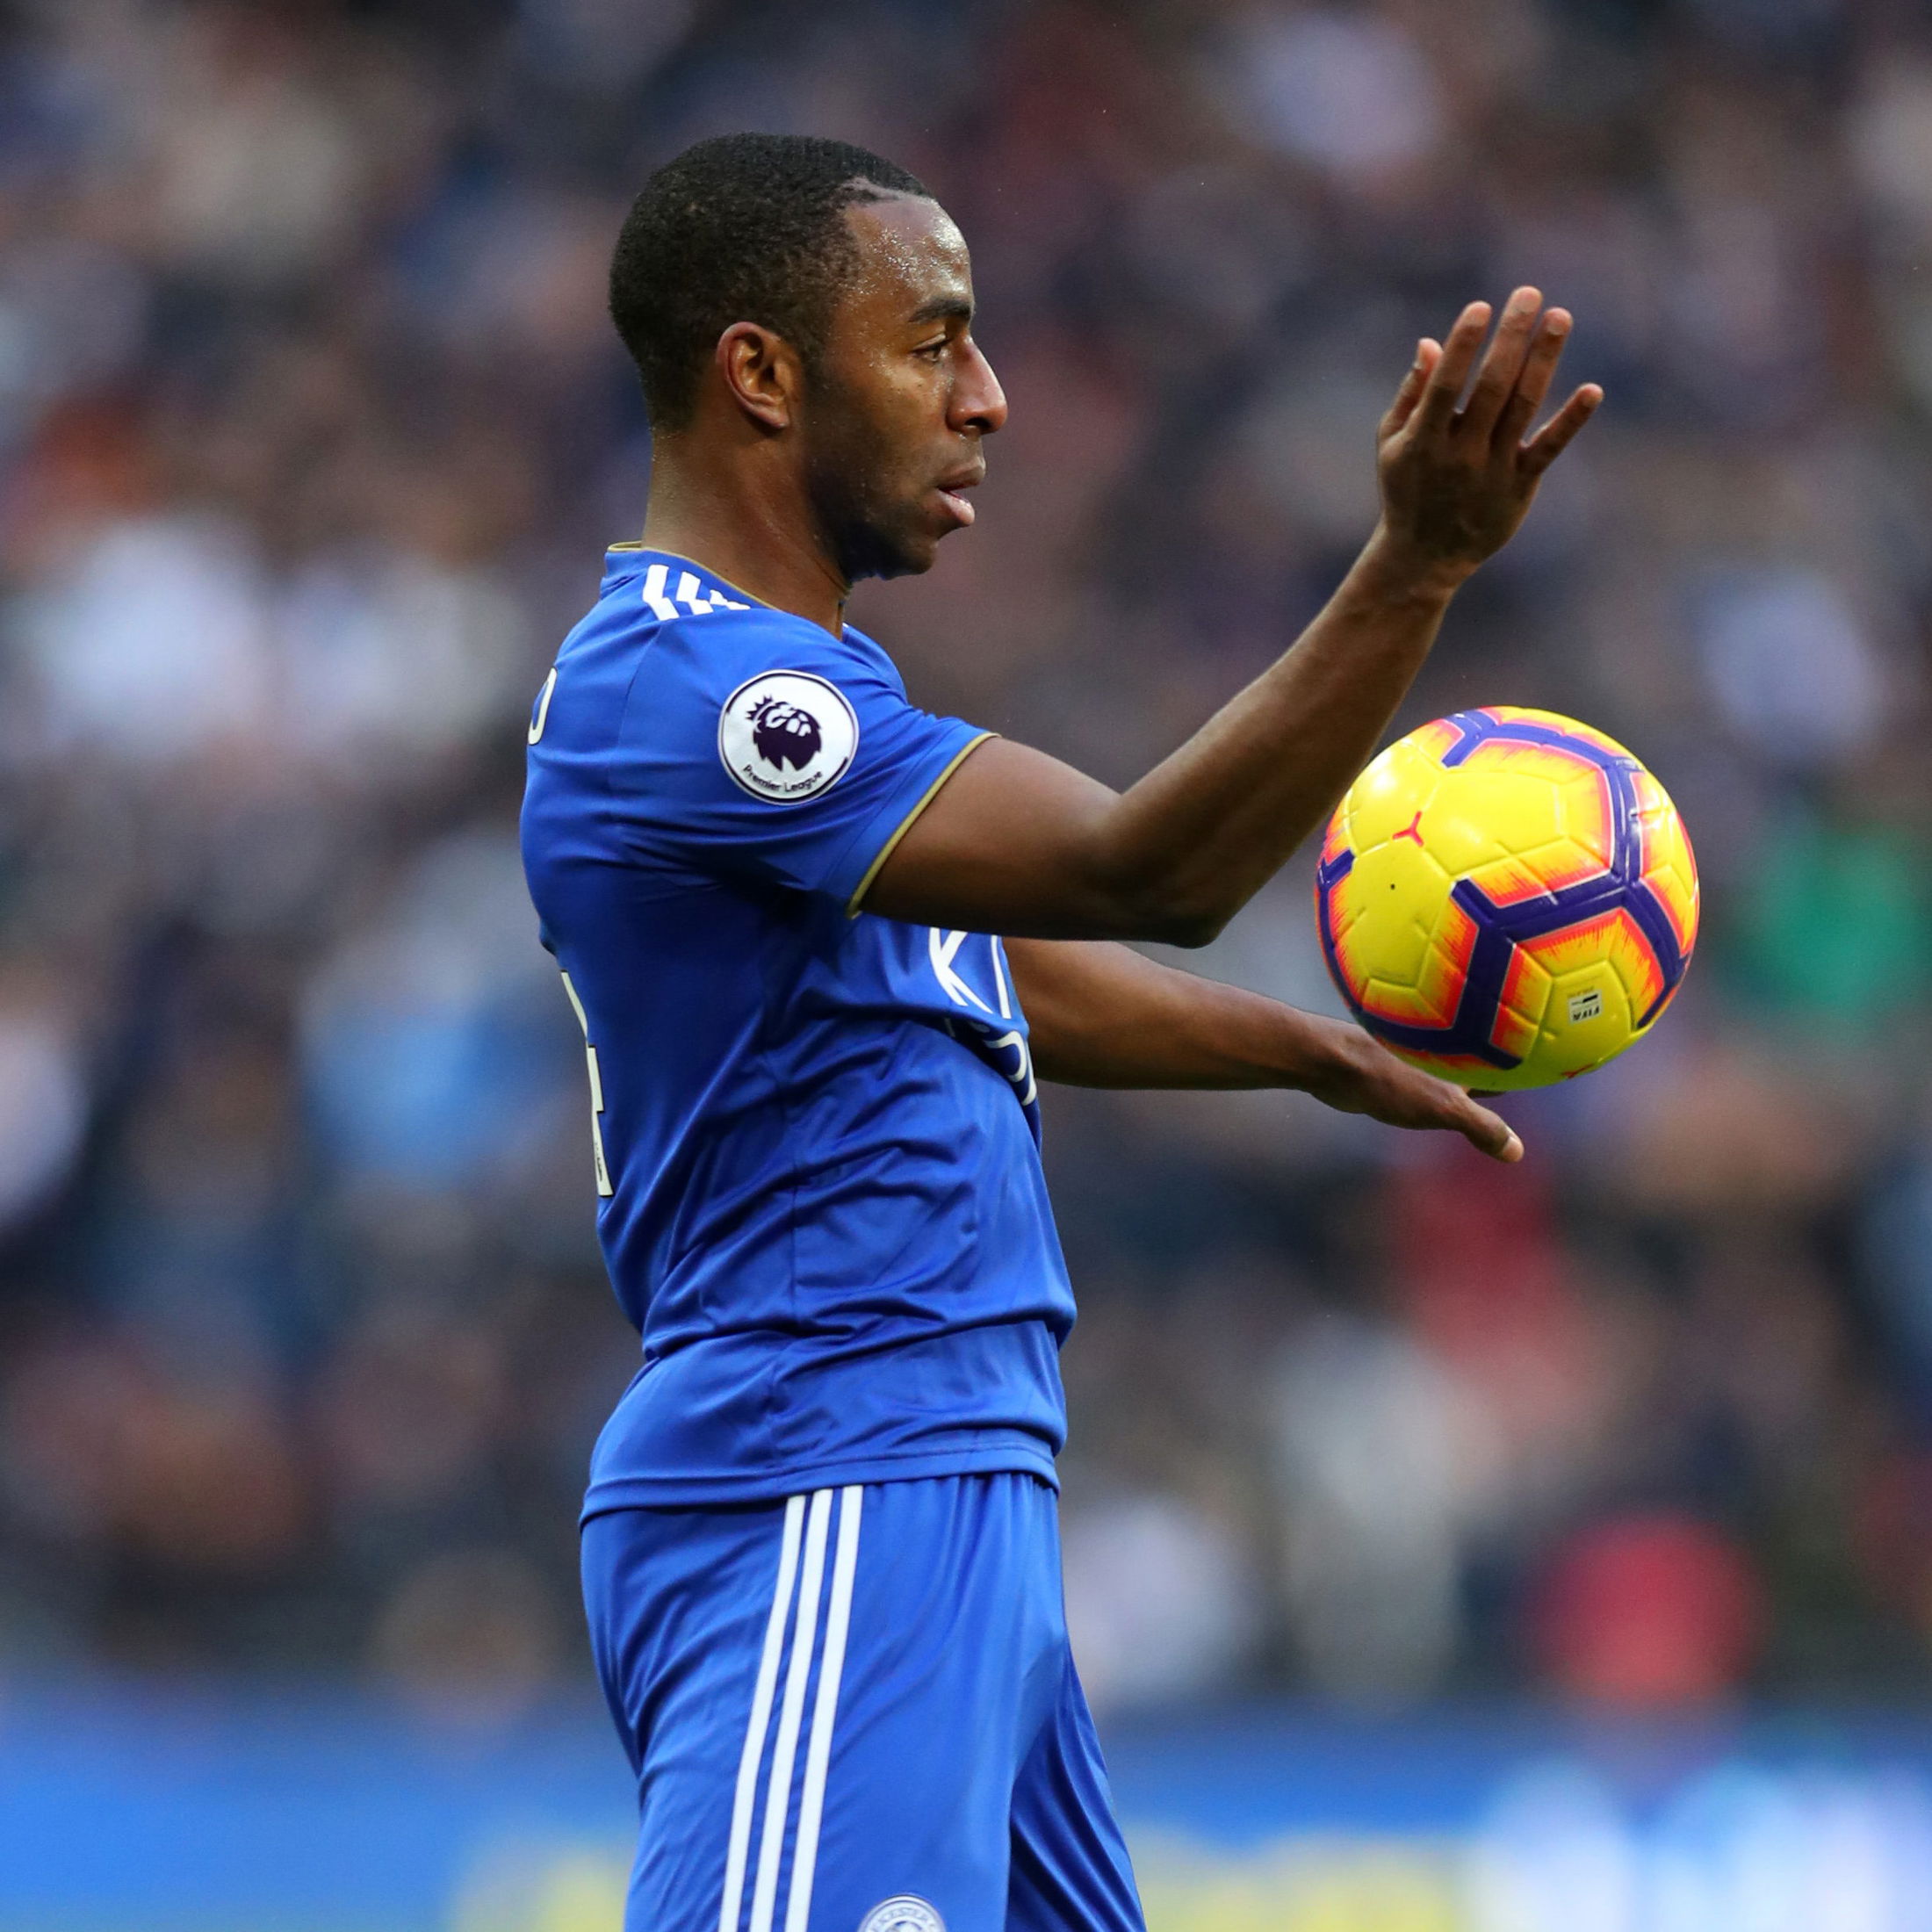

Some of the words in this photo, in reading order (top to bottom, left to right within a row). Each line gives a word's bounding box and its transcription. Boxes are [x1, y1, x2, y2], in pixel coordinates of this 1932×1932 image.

[743, 764, 781, 790] Premier
[784, 771, 823, 792] League
[1572, 1005, 1600, 1021] FIFA
